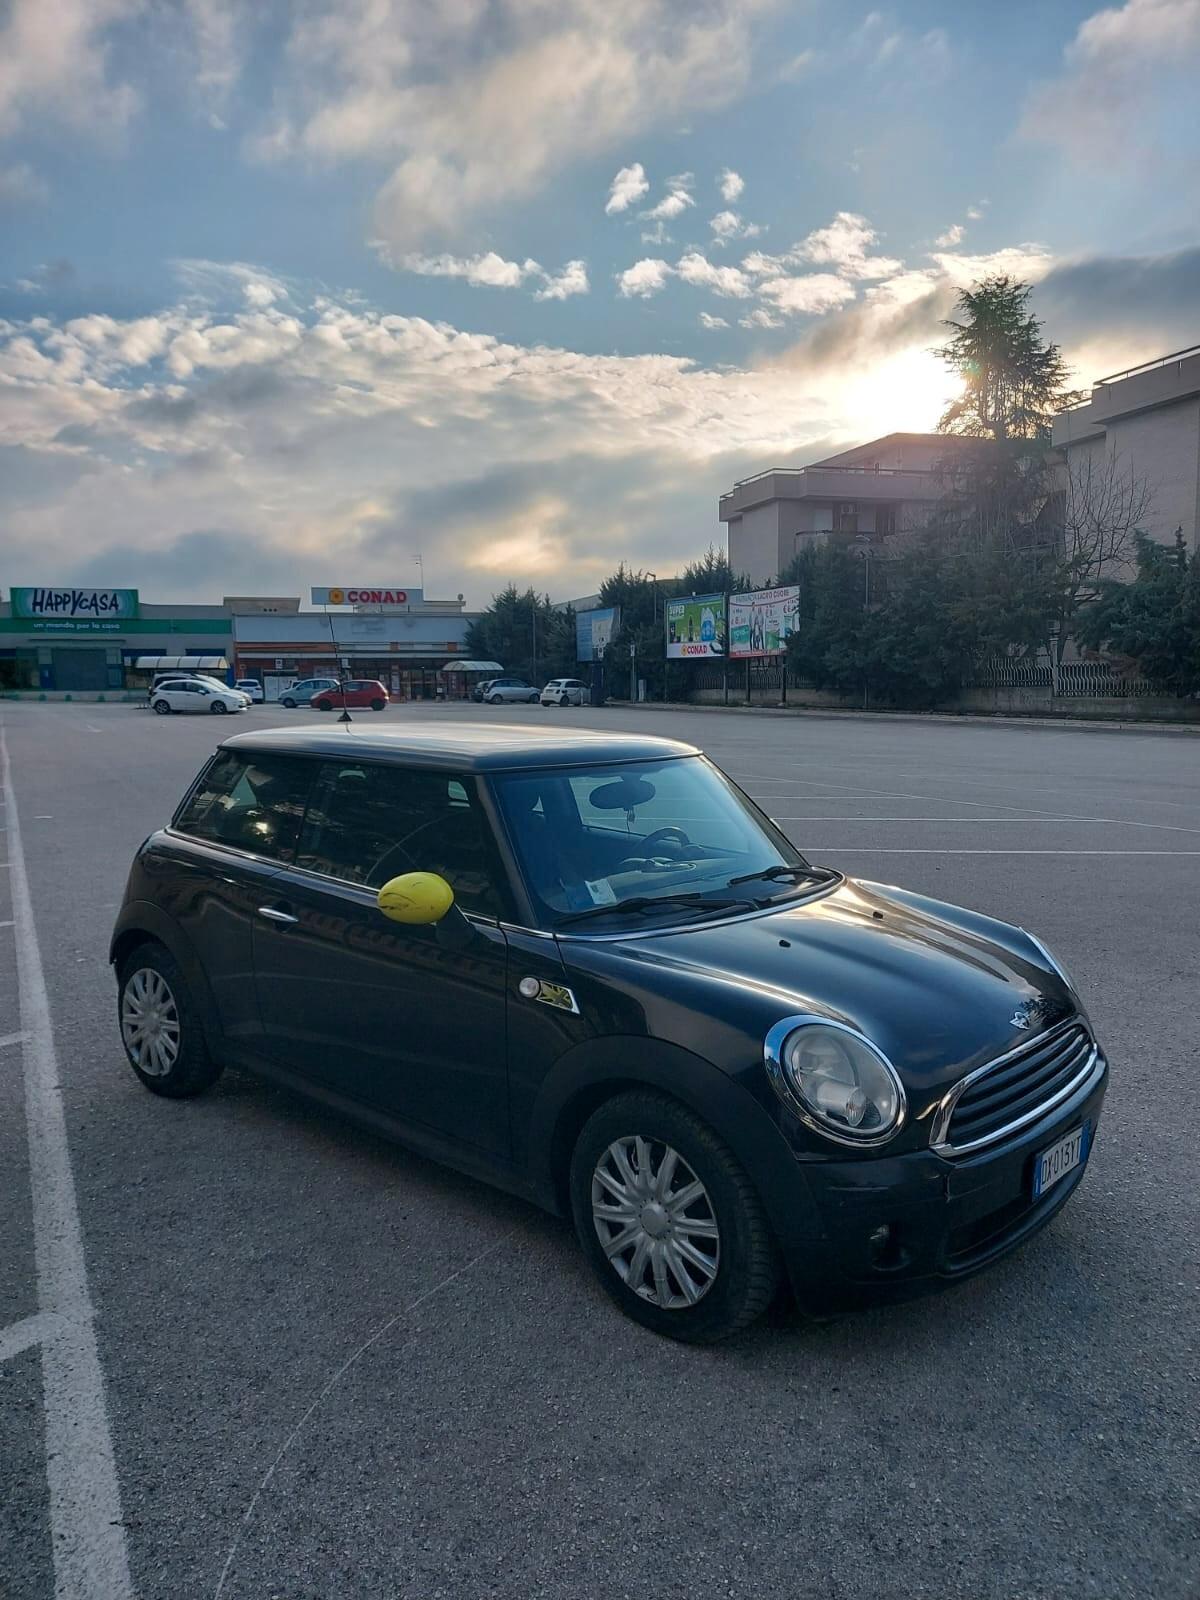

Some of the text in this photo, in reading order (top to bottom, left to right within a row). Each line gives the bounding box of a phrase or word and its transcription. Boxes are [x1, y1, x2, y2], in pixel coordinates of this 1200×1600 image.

[348, 591, 407, 603] CONAD
[46, 621, 75, 629] mondo
[687, 644, 708, 655] CONAD
